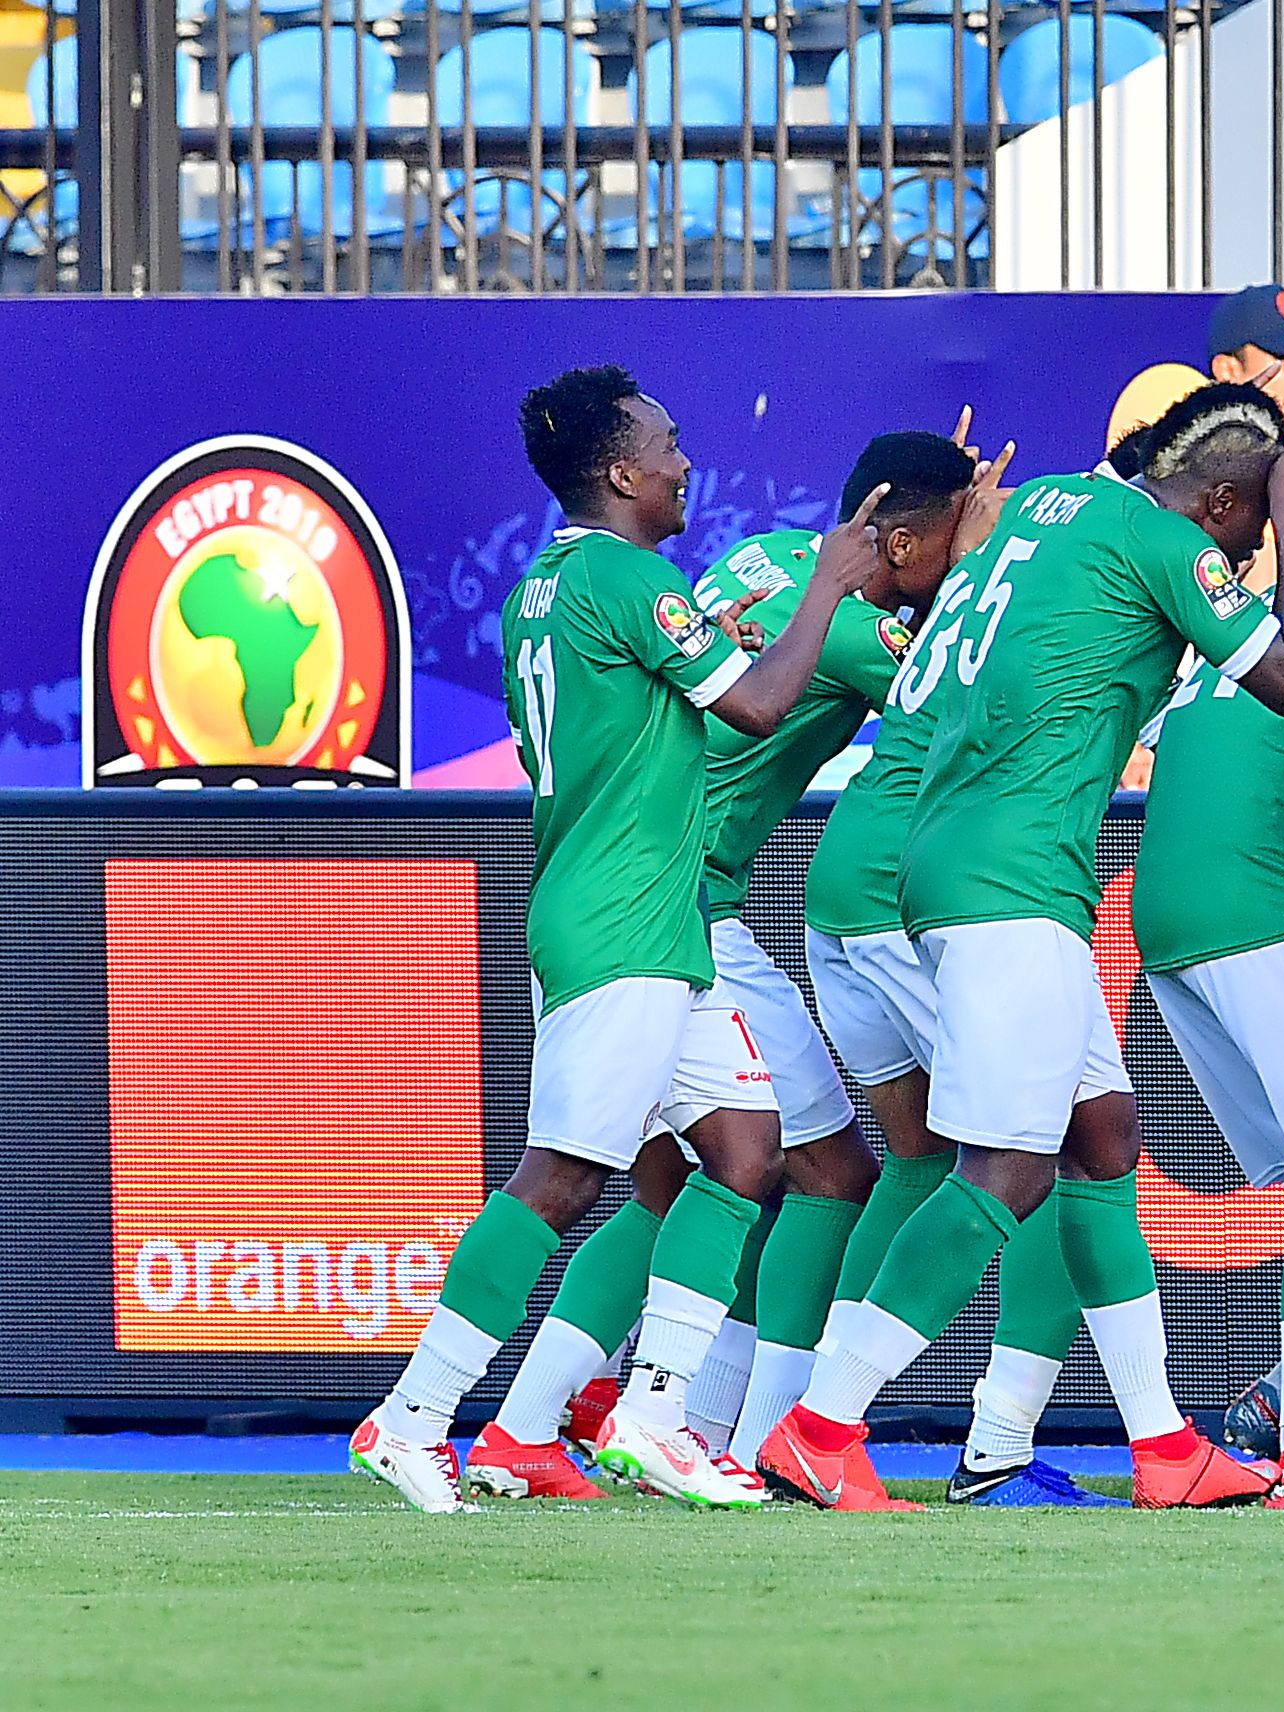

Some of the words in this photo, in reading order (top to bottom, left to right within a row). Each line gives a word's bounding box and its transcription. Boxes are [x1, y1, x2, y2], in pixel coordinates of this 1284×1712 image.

[155, 479, 254, 559] EGYPT
[258, 485, 337, 562] 2019
[516, 634, 554, 797] 11
[133, 1238, 446, 1340] orange
